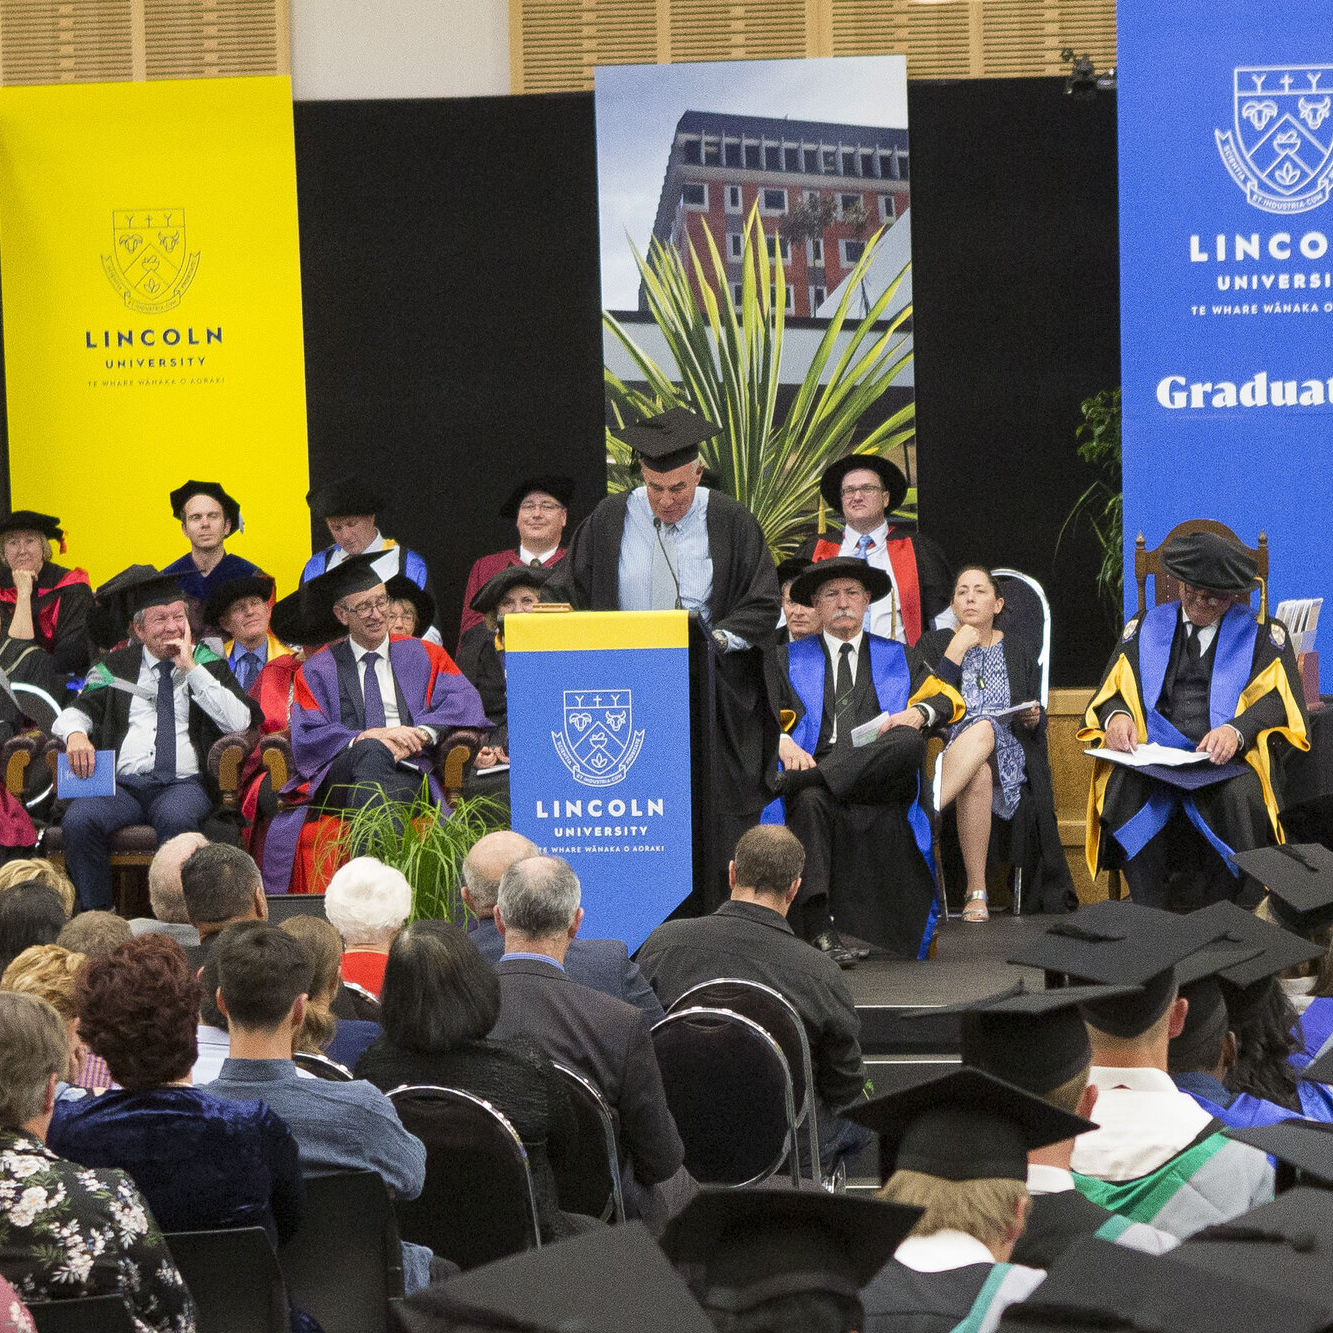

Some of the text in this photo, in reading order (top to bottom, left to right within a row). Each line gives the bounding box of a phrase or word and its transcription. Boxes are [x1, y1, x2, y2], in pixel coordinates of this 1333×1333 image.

[1191, 306, 1207, 316] TE
[1212, 303, 1258, 315] WHARE
[1324, 303, 1333, 312] O
[85, 326, 223, 348] LINCOLN
[105, 357, 206, 369] UNIVERSITY
[536, 799, 664, 818] LINCOLN
[554, 826, 648, 837] UNIVERSITY
